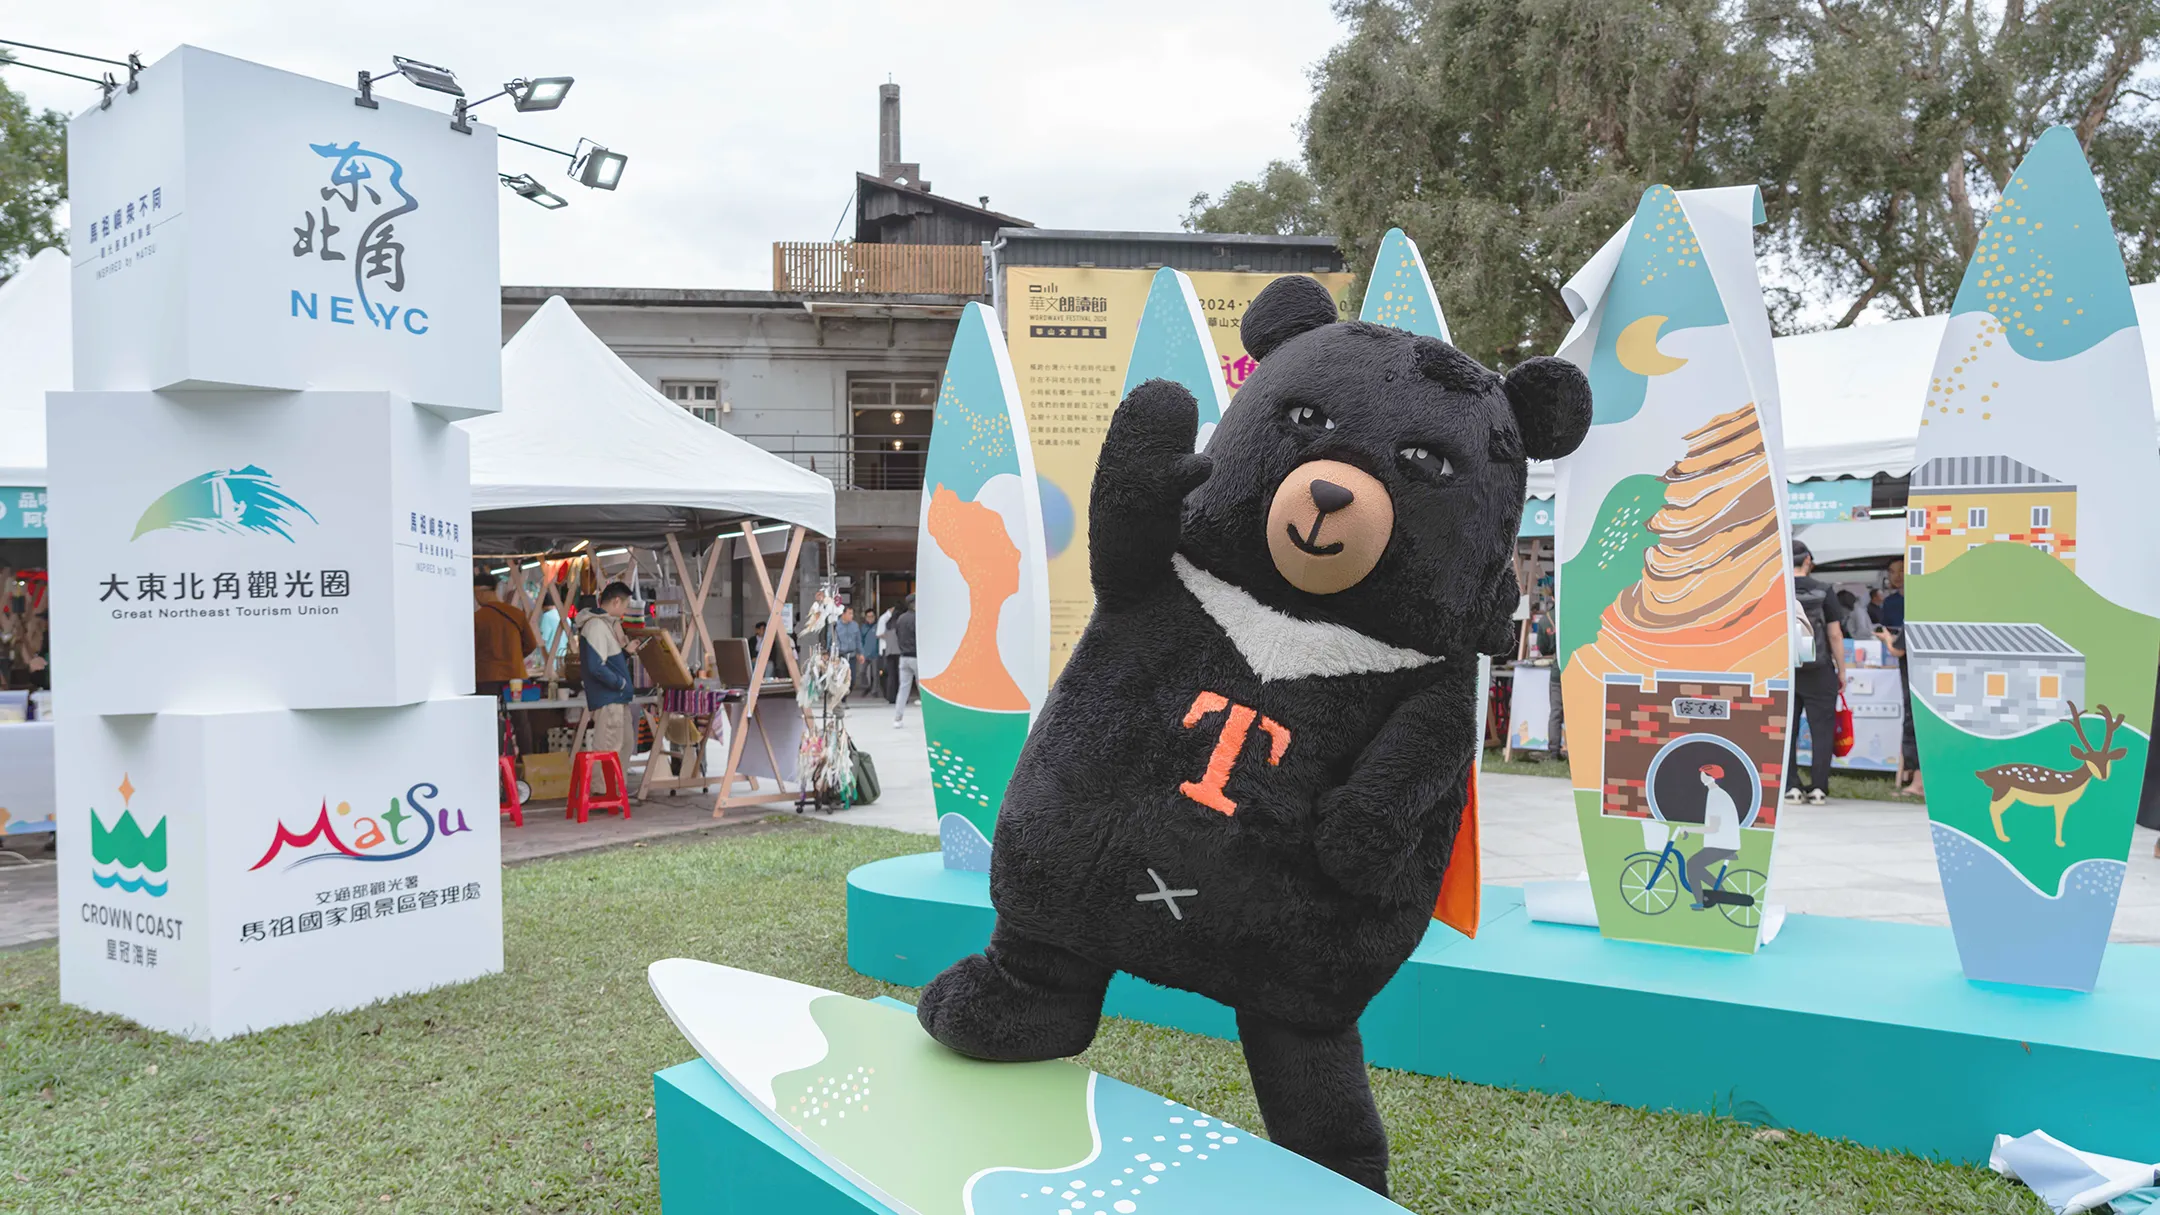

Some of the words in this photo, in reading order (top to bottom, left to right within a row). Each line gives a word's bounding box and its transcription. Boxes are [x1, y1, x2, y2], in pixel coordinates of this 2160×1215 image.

[96, 260, 122, 281] INSPIRED
[125, 256, 133, 268] by
[136, 243, 157, 260] MATSU
[1029, 296, 1107, 312] 華文朗讀節
[1035, 328, 1101, 337] 華山文創園區
[99, 569, 350, 602] 大東北角觀光圈
[111, 608, 153, 619] Great
[158, 607, 231, 619] Northeast
[236, 605, 292, 617] Tourism
[297, 605, 339, 616] Union
[1179, 690, 1291, 817] T
[315, 875, 419, 906] 交通部觀光署
[81, 902, 132, 931] CROWN
[136, 912, 183, 941] COAST
[240, 881, 481, 944] 馬祖國家風景區管理處
[106, 938, 158, 969] 皇冠海岸
